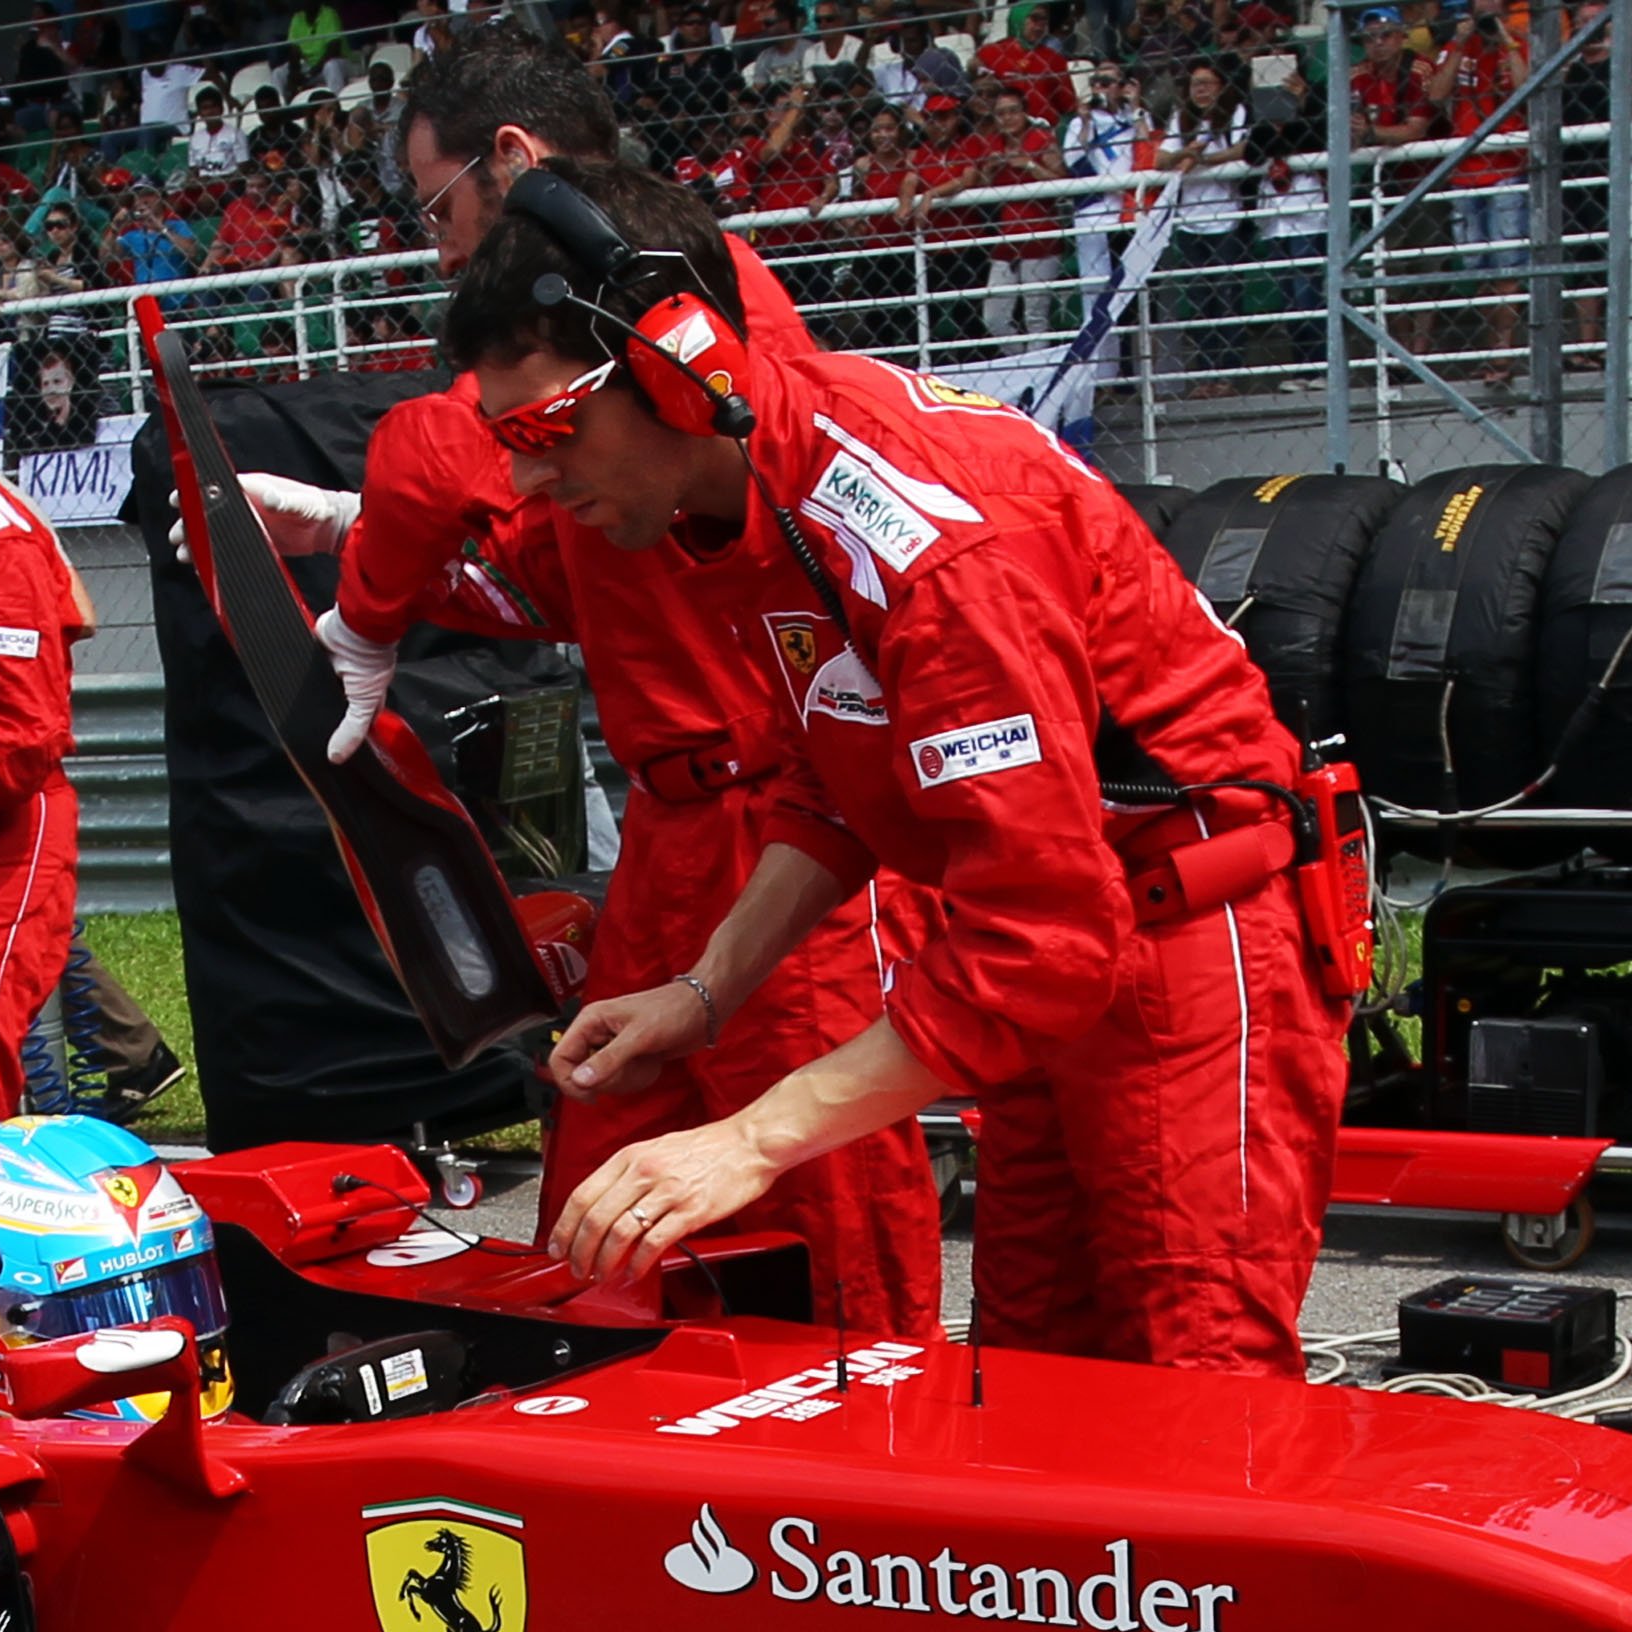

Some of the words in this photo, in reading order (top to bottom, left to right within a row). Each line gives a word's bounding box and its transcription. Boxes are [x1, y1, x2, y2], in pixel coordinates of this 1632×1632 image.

[29, 450, 117, 503] KIMI,
[940, 725, 1029, 759] WEICHAI
[99, 1243, 166, 1275] HUBLOT
[656, 1341, 925, 1436] WEICHAI
